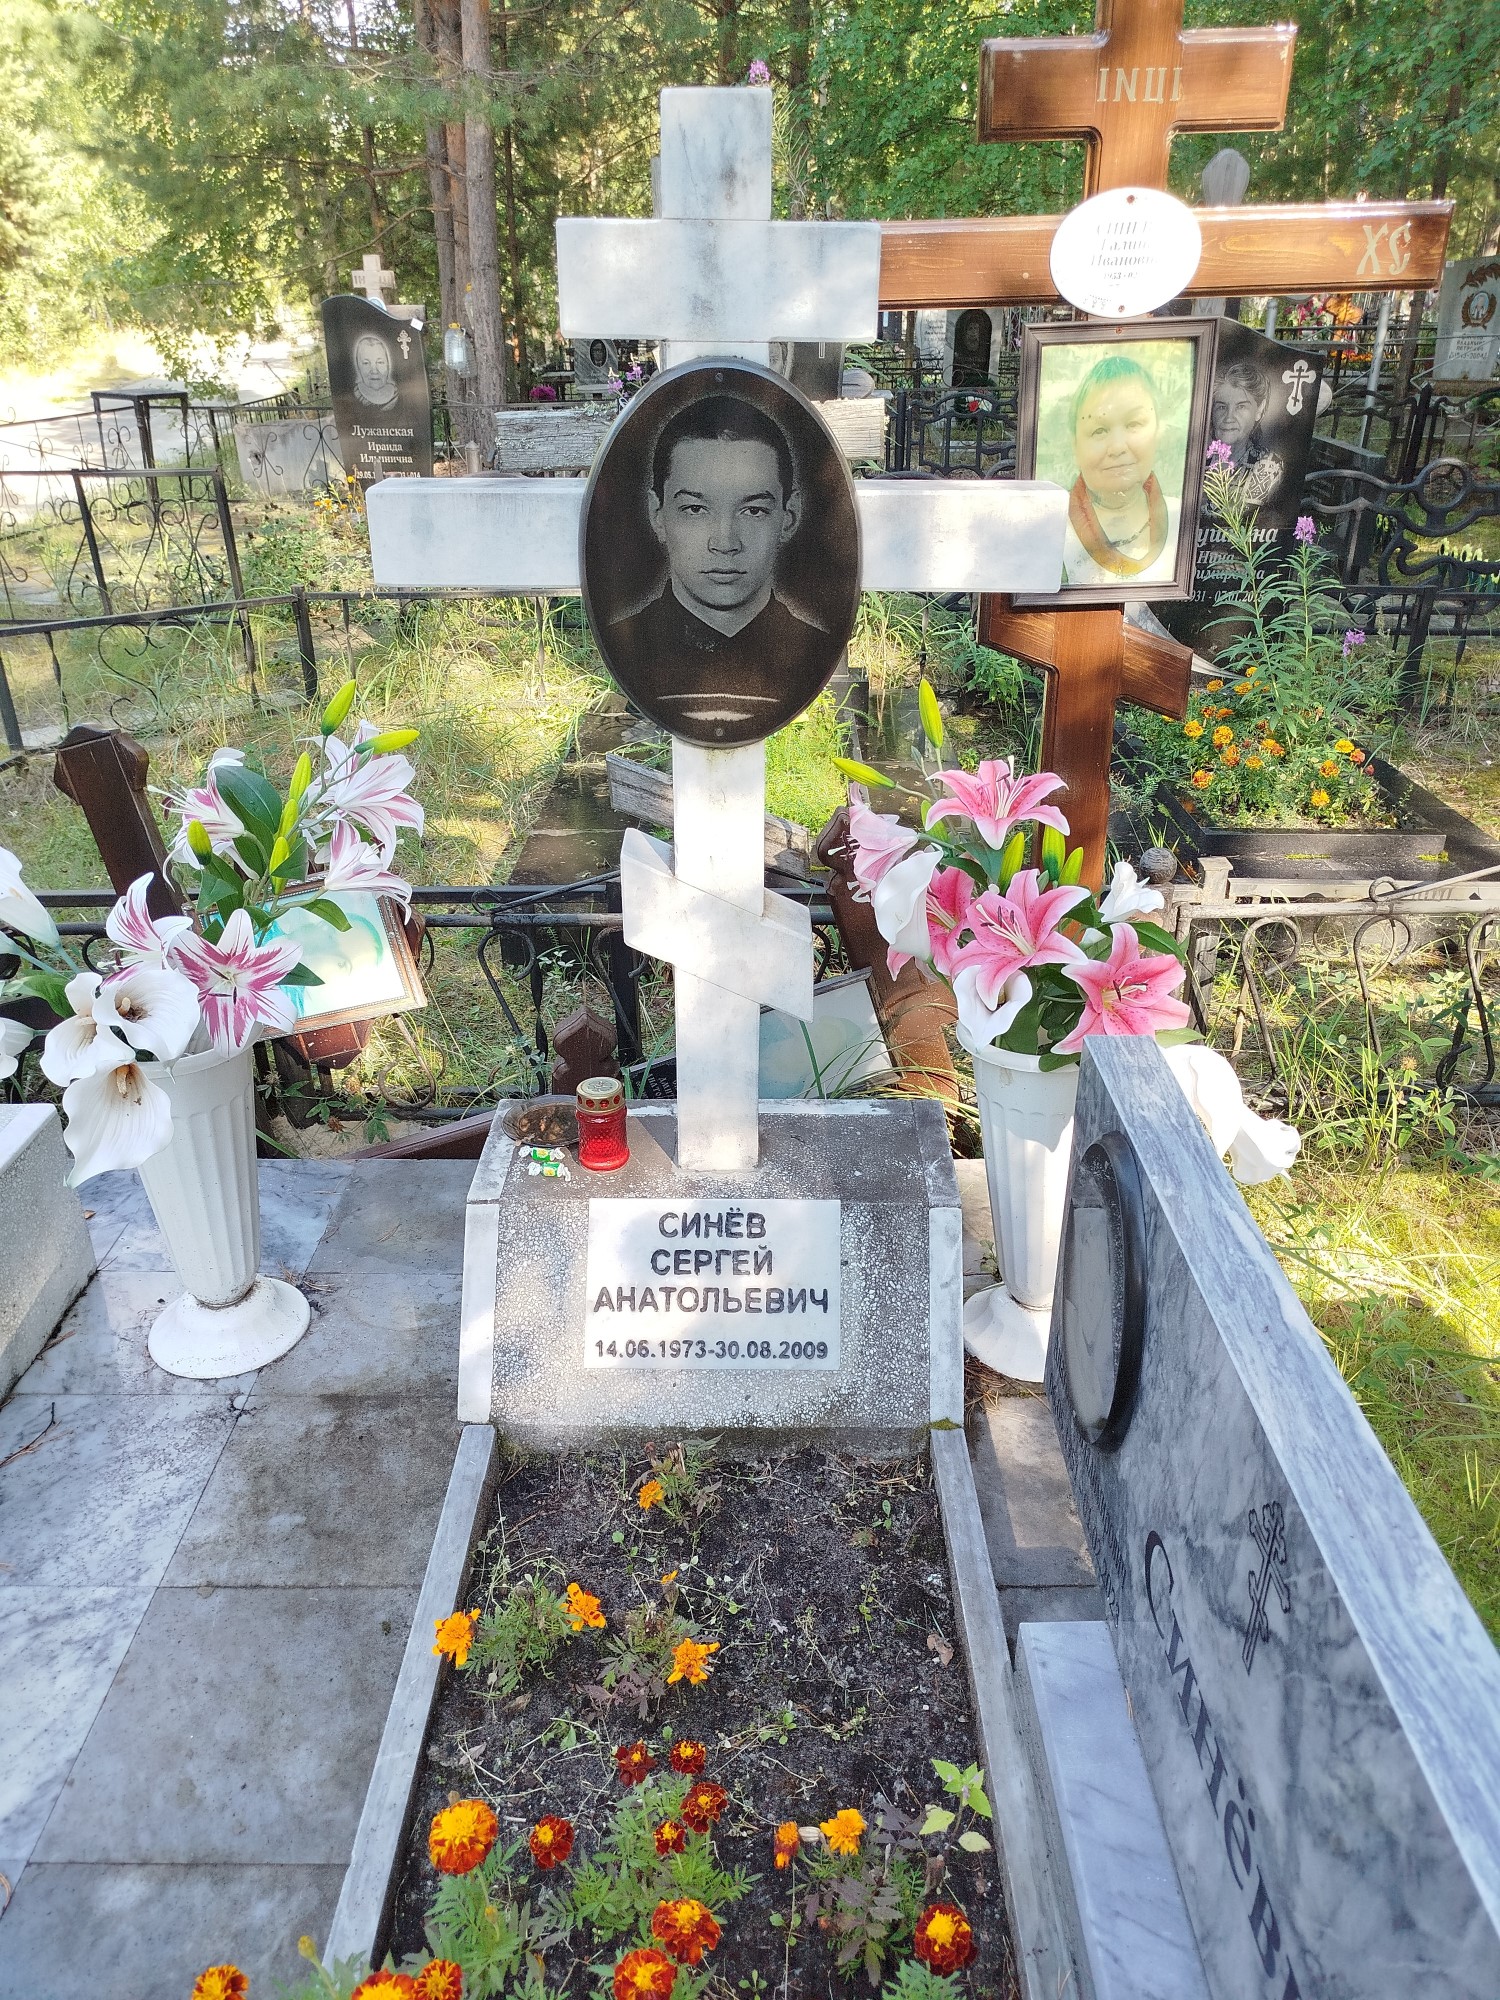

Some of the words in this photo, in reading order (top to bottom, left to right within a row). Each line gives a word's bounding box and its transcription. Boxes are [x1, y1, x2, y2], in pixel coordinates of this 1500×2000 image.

[351, 425, 414, 438] Лужанская
[368, 441, 403, 453] Ираида
[658, 1207, 767, 1238] СИНЁВ
[650, 1245, 773, 1276] СЕРГЕЙ
[593, 1286, 829, 1314] АНАТОЛЬЕВИЧ
[595, 1340, 829, 1360] 14.06.1973-30.08.2009
[1144, 1530, 1303, 2000] Синёв
